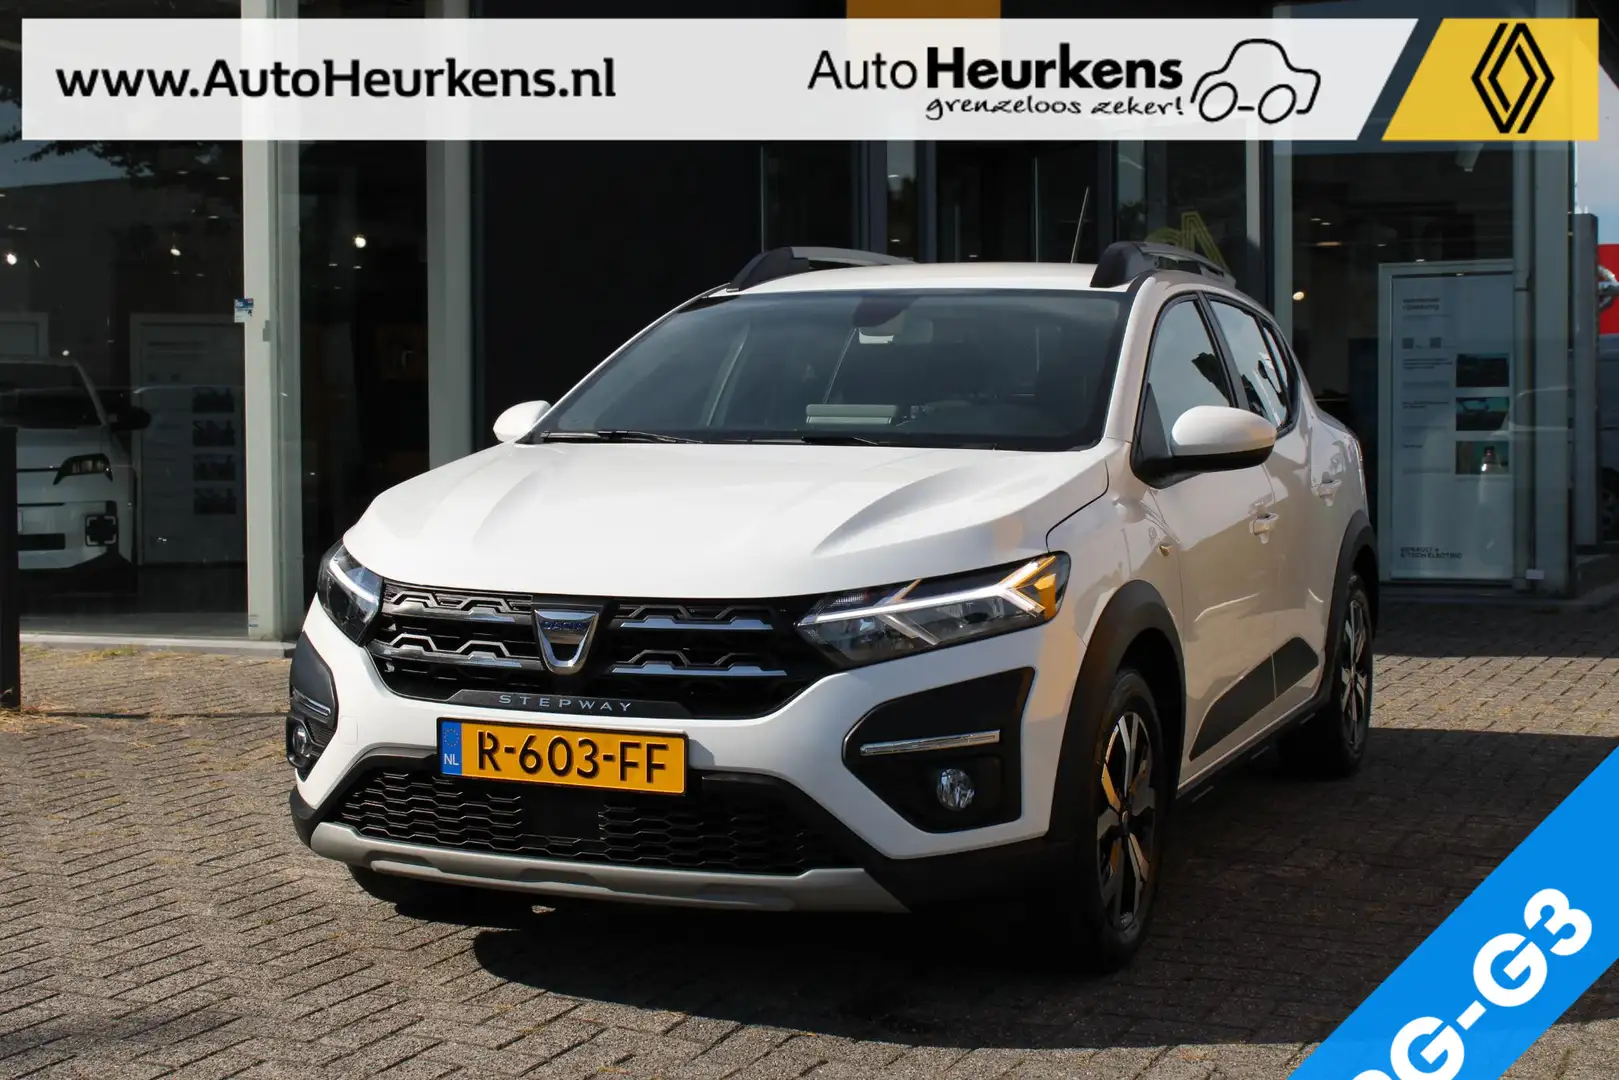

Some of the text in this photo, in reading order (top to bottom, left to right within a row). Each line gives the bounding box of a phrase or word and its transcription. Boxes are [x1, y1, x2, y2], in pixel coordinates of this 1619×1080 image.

[498, 693, 632, 712] STEPWAY
[443, 752, 460, 766] NL
[477, 731, 669, 784] R-603-FF
